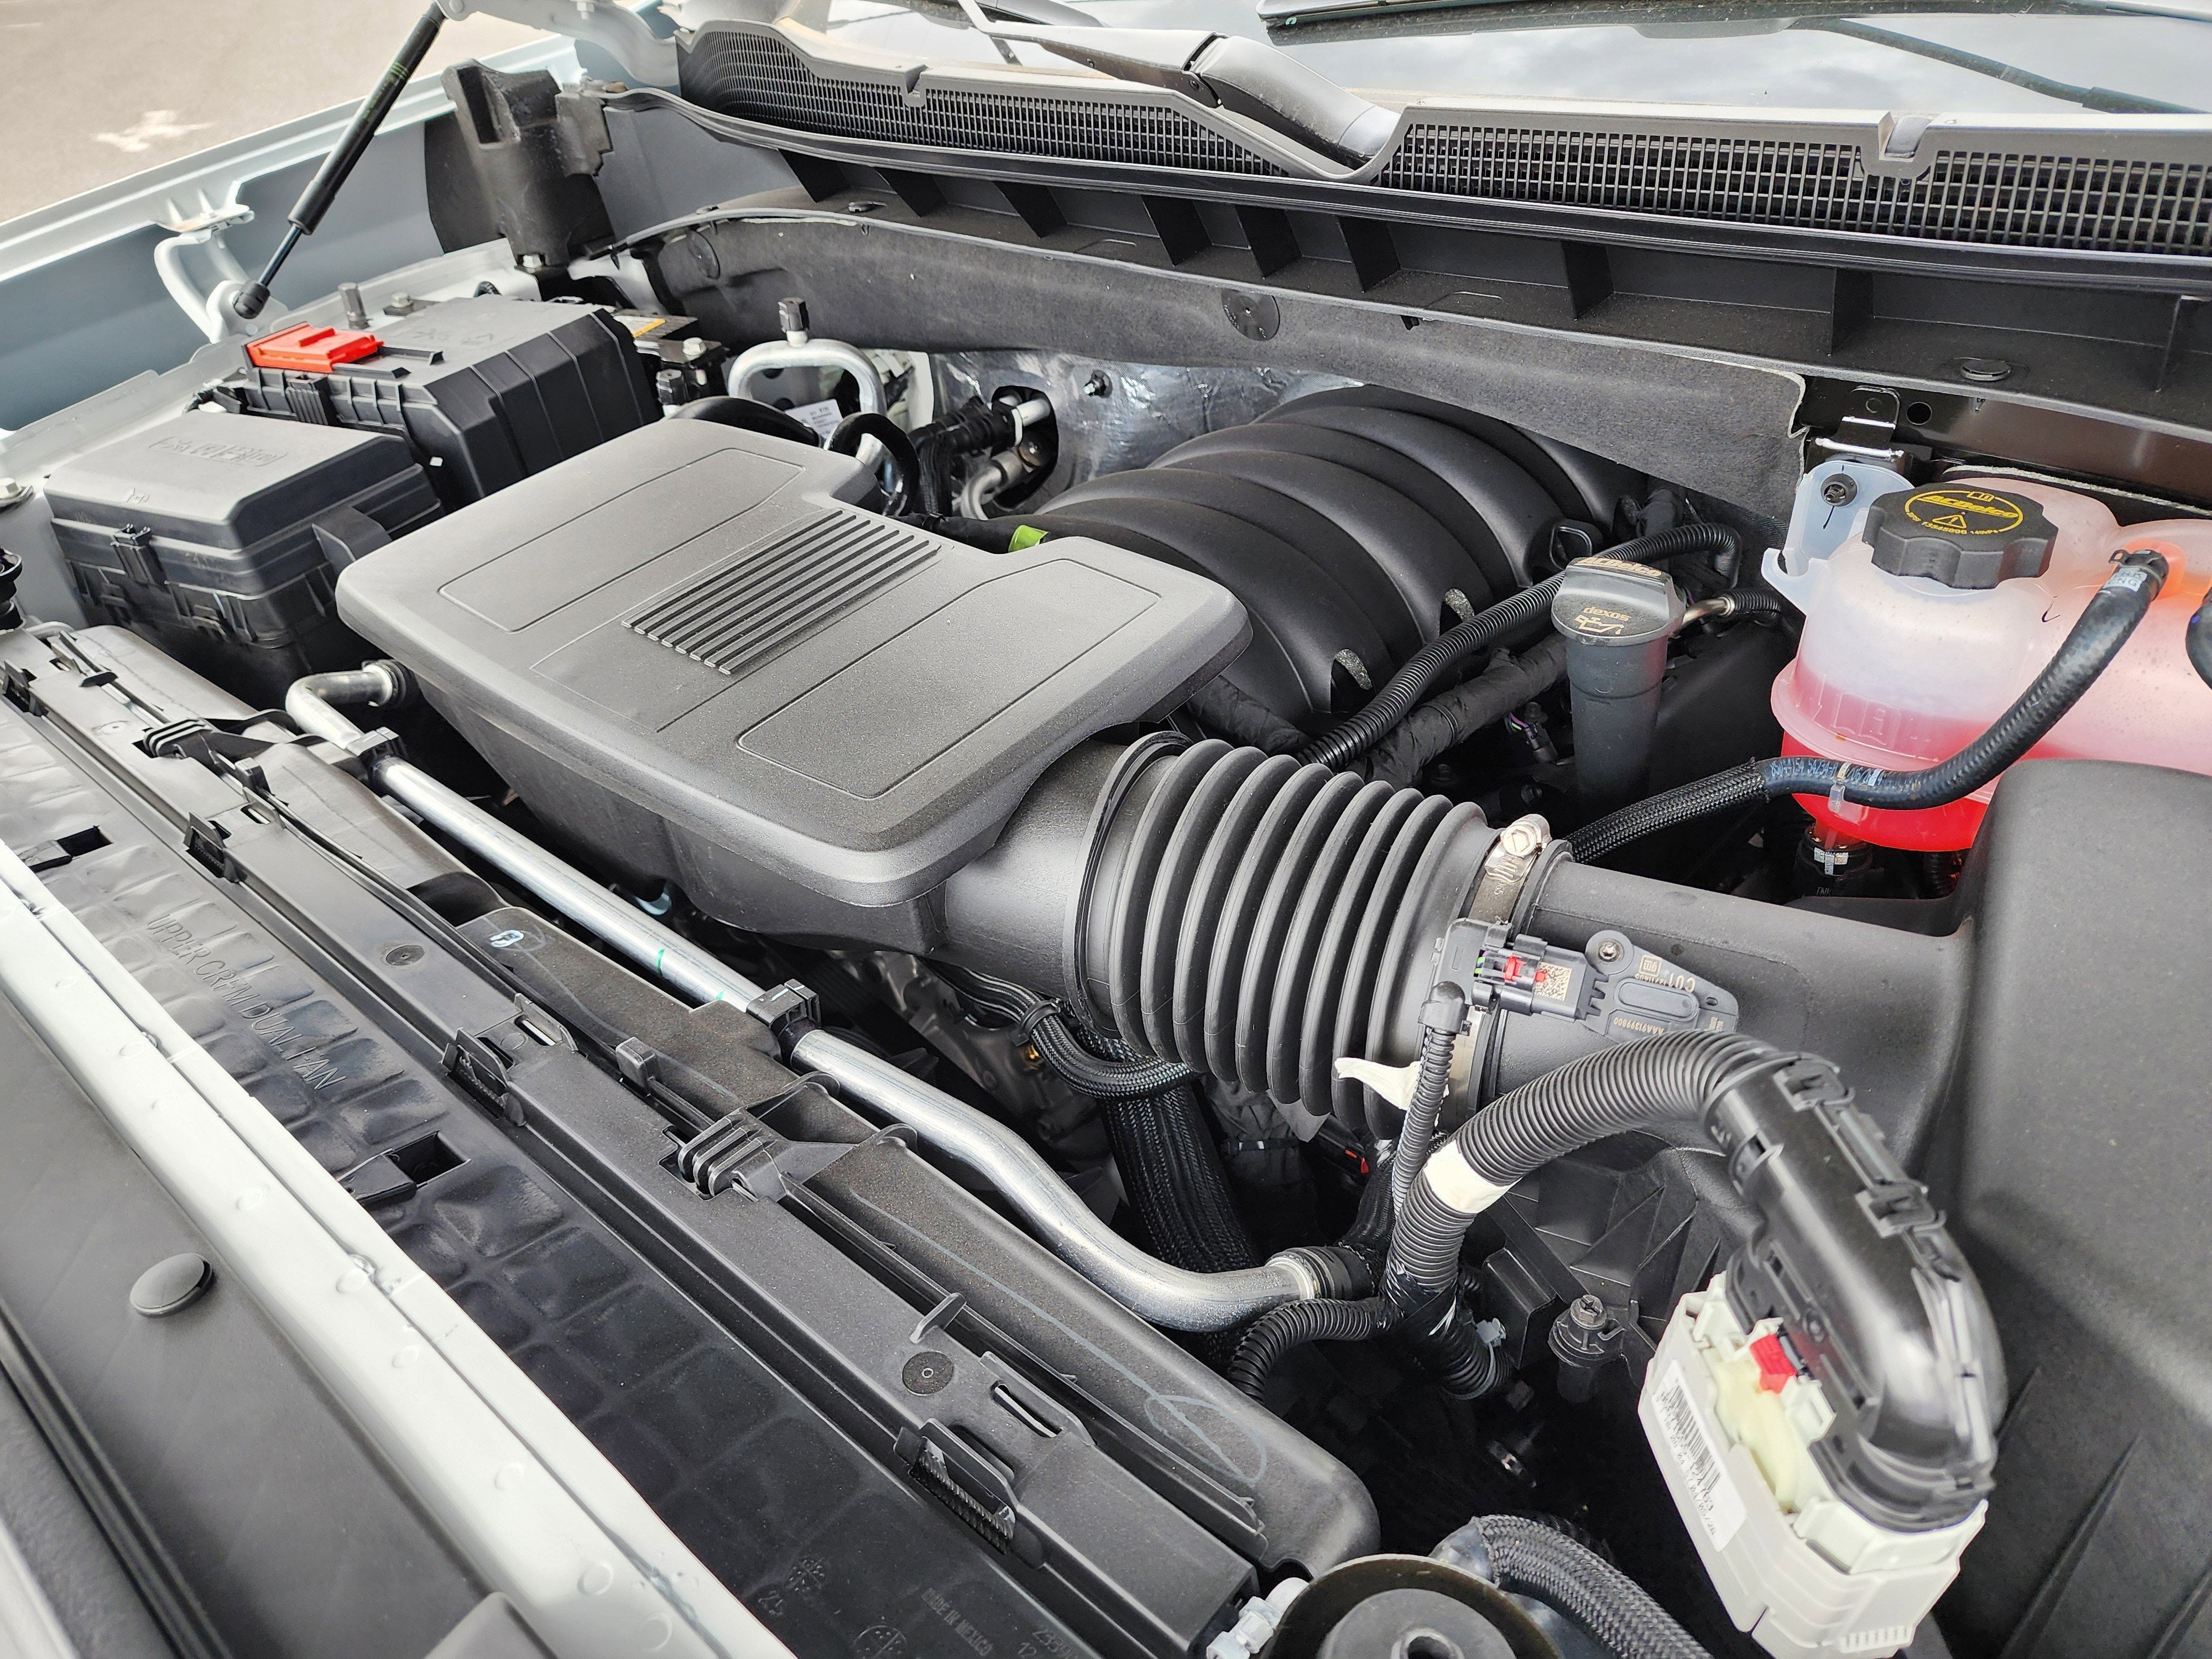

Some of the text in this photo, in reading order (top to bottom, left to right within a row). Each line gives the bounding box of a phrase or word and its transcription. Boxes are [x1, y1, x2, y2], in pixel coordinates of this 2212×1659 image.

[1921, 495, 2019, 518] ACDelco
[1577, 556, 1662, 577] ACDelco
[1583, 606, 1630, 622] dexos
[147, 913, 212, 965] UPPER
[237, 1002, 303, 1053] DUAL
[285, 1046, 348, 1091] FAN
[955, 1619, 993, 1657] MEXICO
